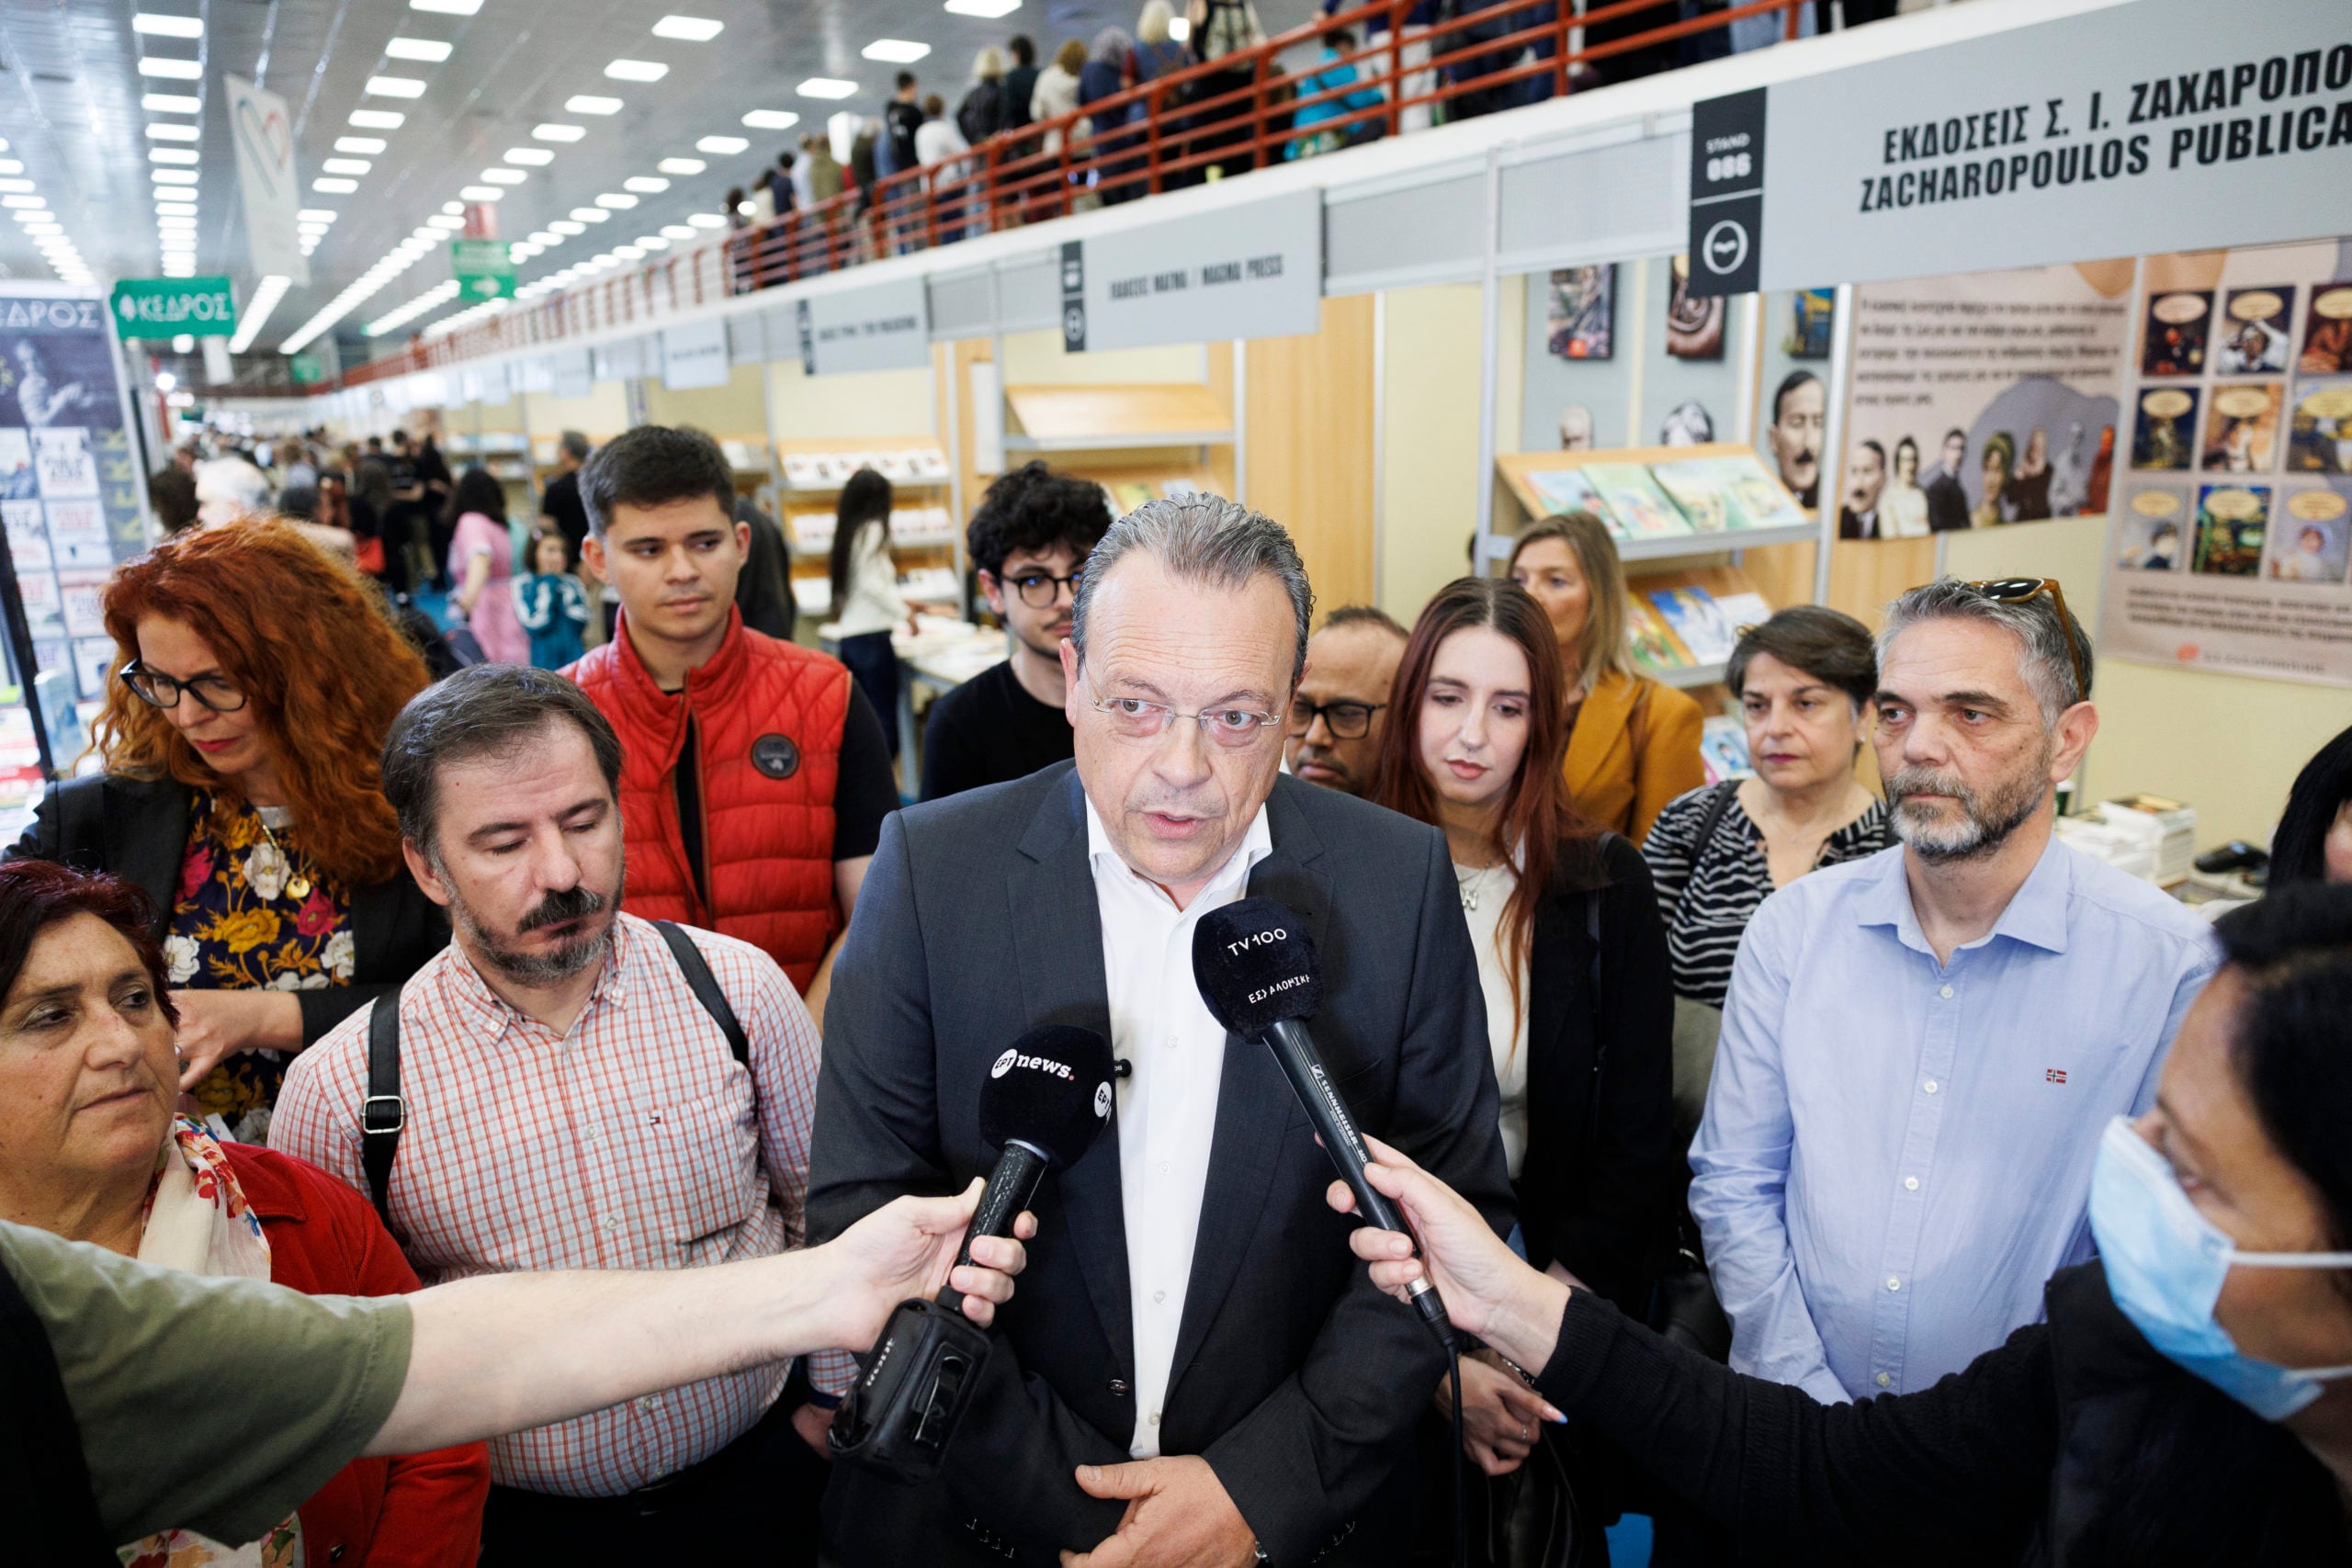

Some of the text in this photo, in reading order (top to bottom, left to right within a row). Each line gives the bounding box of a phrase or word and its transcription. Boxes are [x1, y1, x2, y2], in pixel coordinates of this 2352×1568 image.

[1883, 43, 2352, 165] ΕΚΔΟΣΕΙΣ Σ. Ι. ΖΑΧΑΡΟΠΟ
[1705, 132, 1751, 154] STAND
[1859, 101, 2352, 212] ZACHAROPOULOS PUBLICA
[0, 300, 99, 329] ΔΡΟΣ
[139, 292, 230, 321] ΚΕΔΡΟΣ
[1227, 928, 1287, 956] TV100
[1321, 1079, 1359, 1145] SENNHEISER
